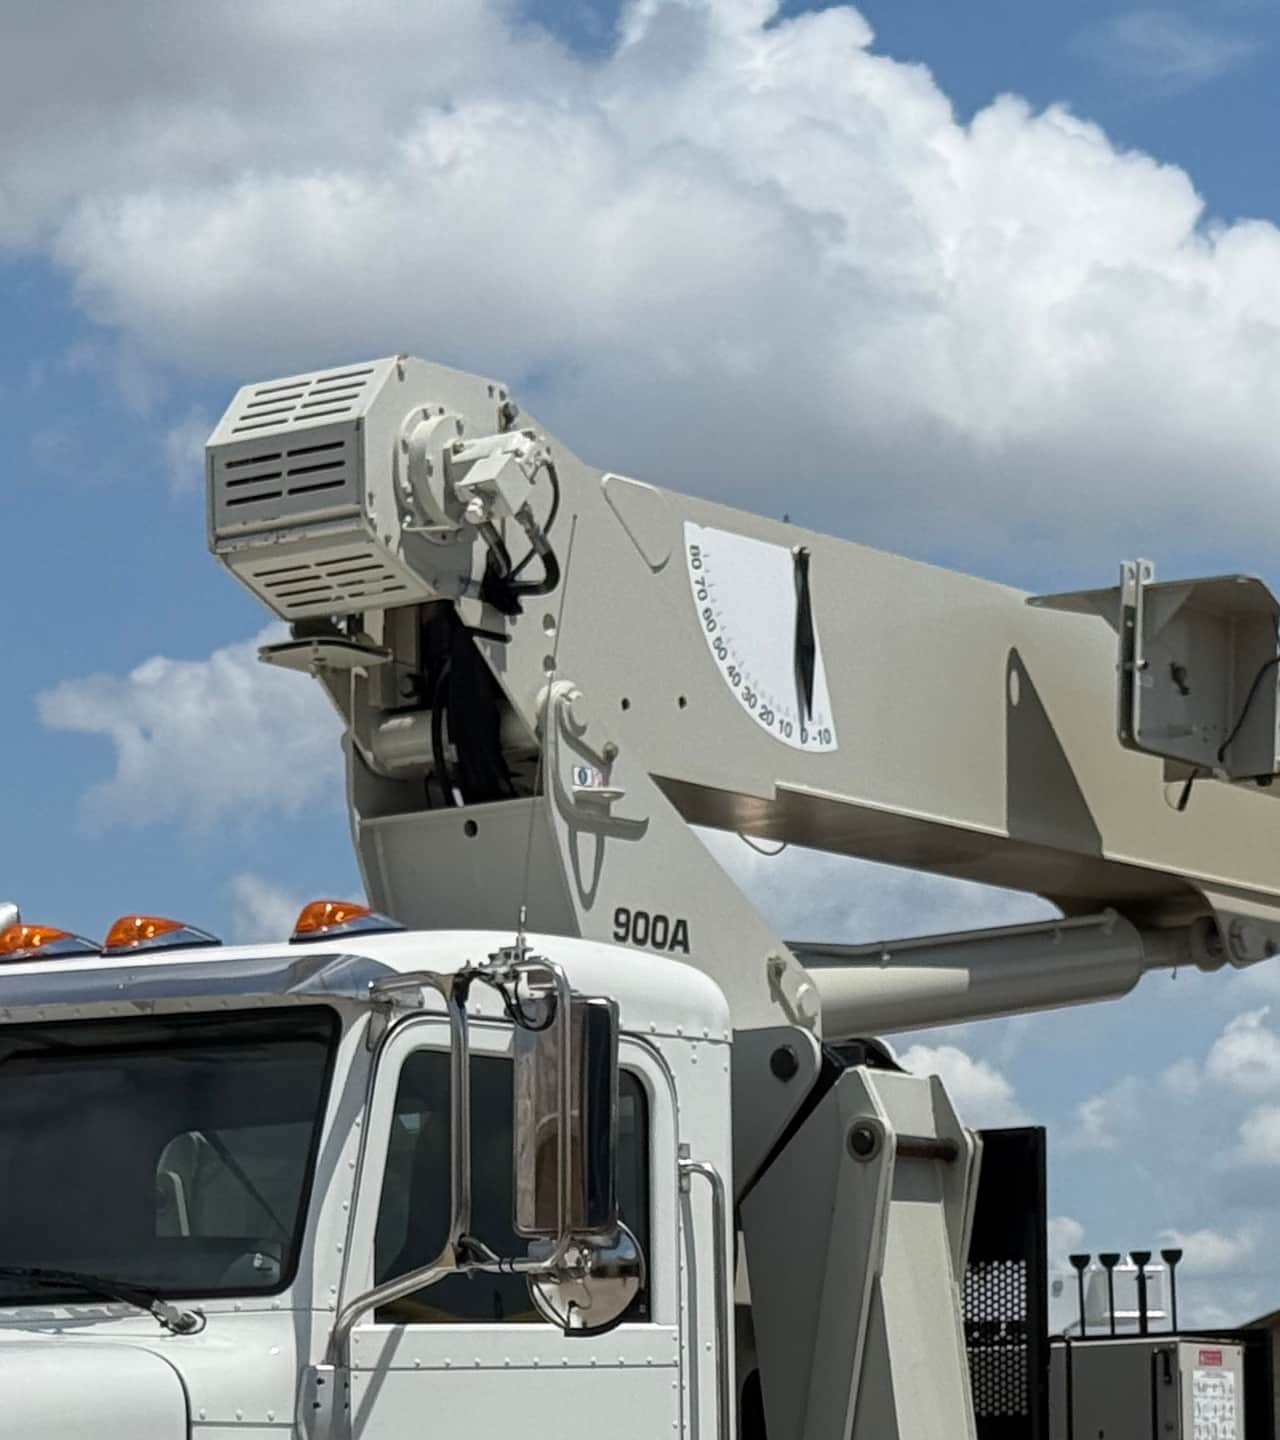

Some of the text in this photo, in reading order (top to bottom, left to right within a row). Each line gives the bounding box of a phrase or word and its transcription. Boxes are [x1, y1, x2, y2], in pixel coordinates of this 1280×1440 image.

[688, 544, 703, 571] 80
[693, 578, 708, 602] 70
[702, 607, 717, 634] 60
[712, 638, 727, 661] 50
[725, 665, 742, 687] 40
[740, 685, 757, 709] 30
[758, 704, 774, 727] 20
[778, 718, 794, 739] 10
[612, 907, 691, 954] 900A
